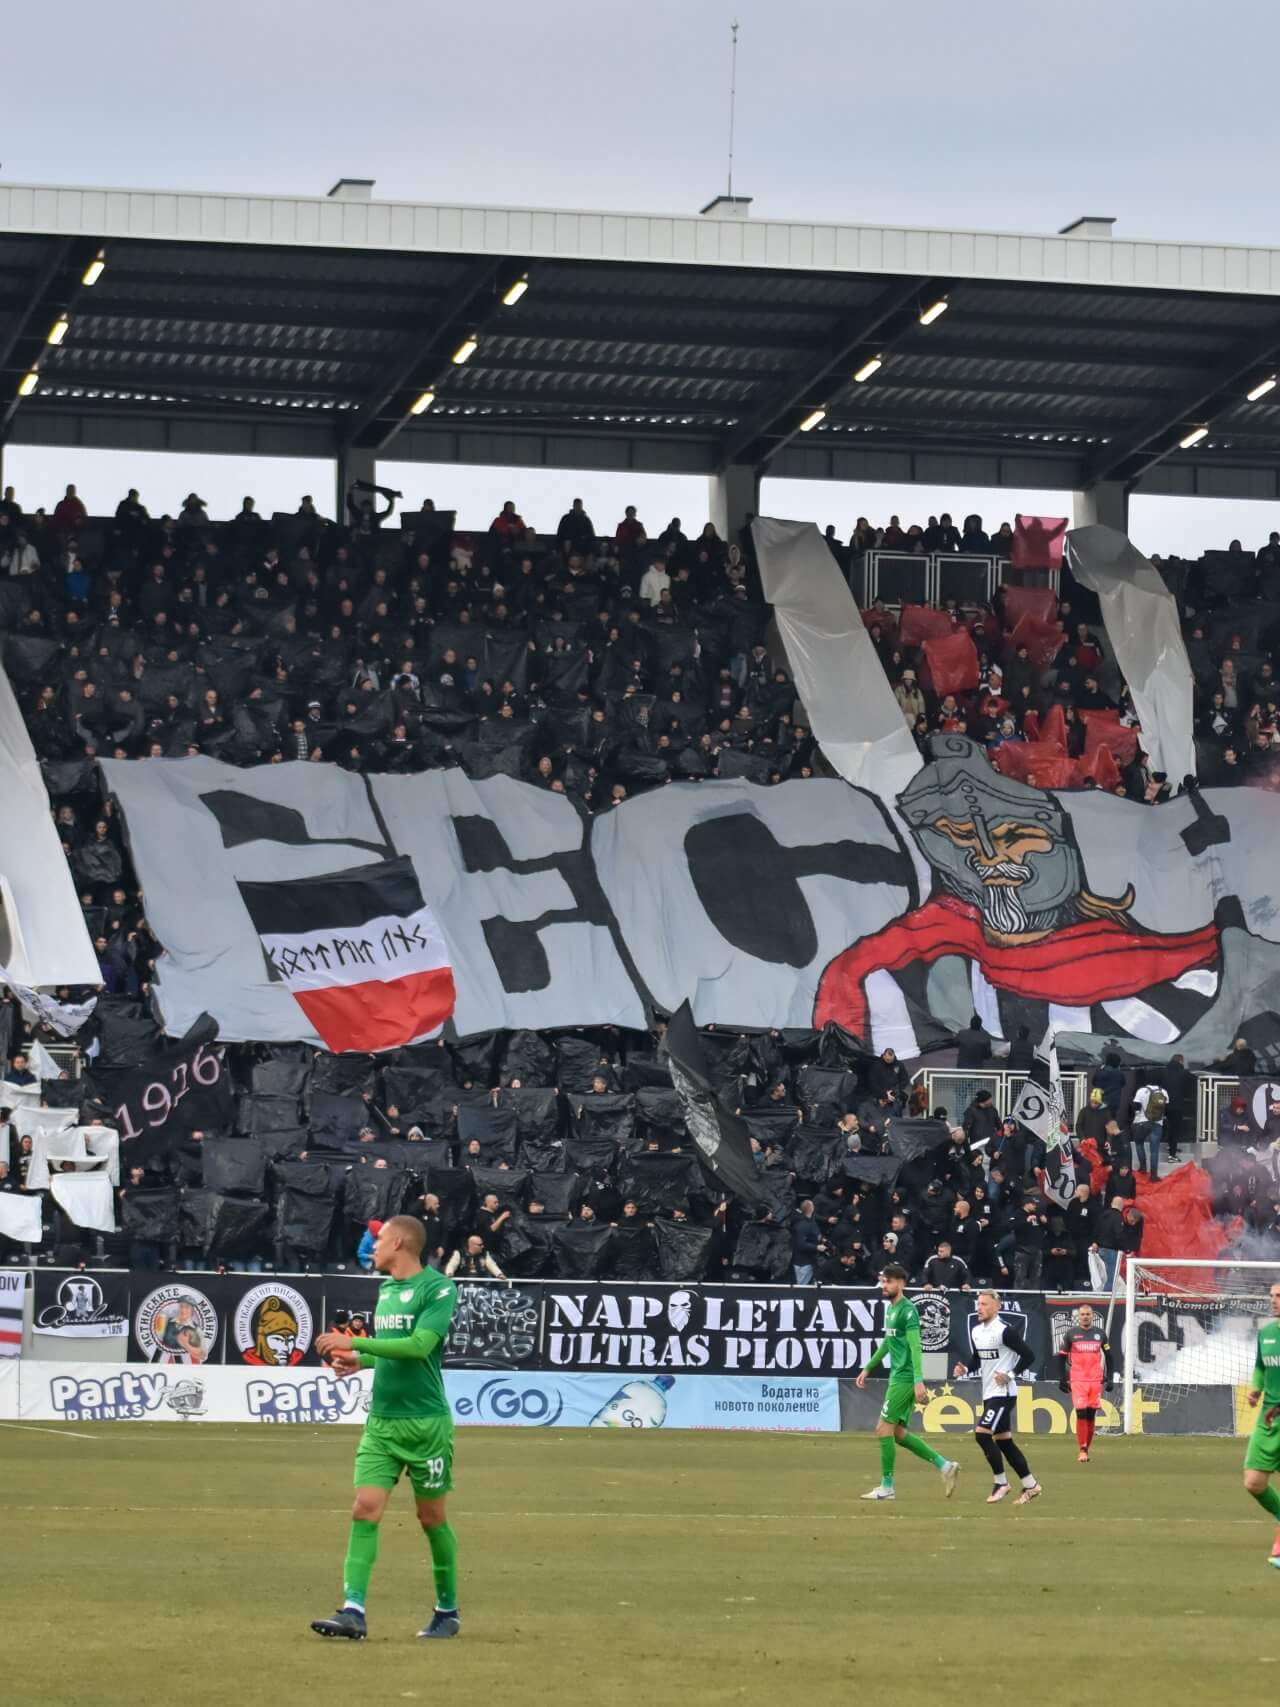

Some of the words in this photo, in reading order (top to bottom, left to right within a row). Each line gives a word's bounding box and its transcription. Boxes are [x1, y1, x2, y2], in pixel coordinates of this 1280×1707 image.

[1161, 1297, 1226, 1310] Lokomotiv
[549, 1333, 710, 1367] ULTRAS
[50, 1372, 167, 1412] Party
[246, 1376, 362, 1416] Party
[761, 1384, 803, 1400] Водата
[806, 1388, 819, 1398] на
[65, 1403, 143, 1421] DRINKS
[714, 1401, 754, 1412] новото
[922, 1385, 1160, 1434] ebet
[427, 1457, 444, 1479] 19
